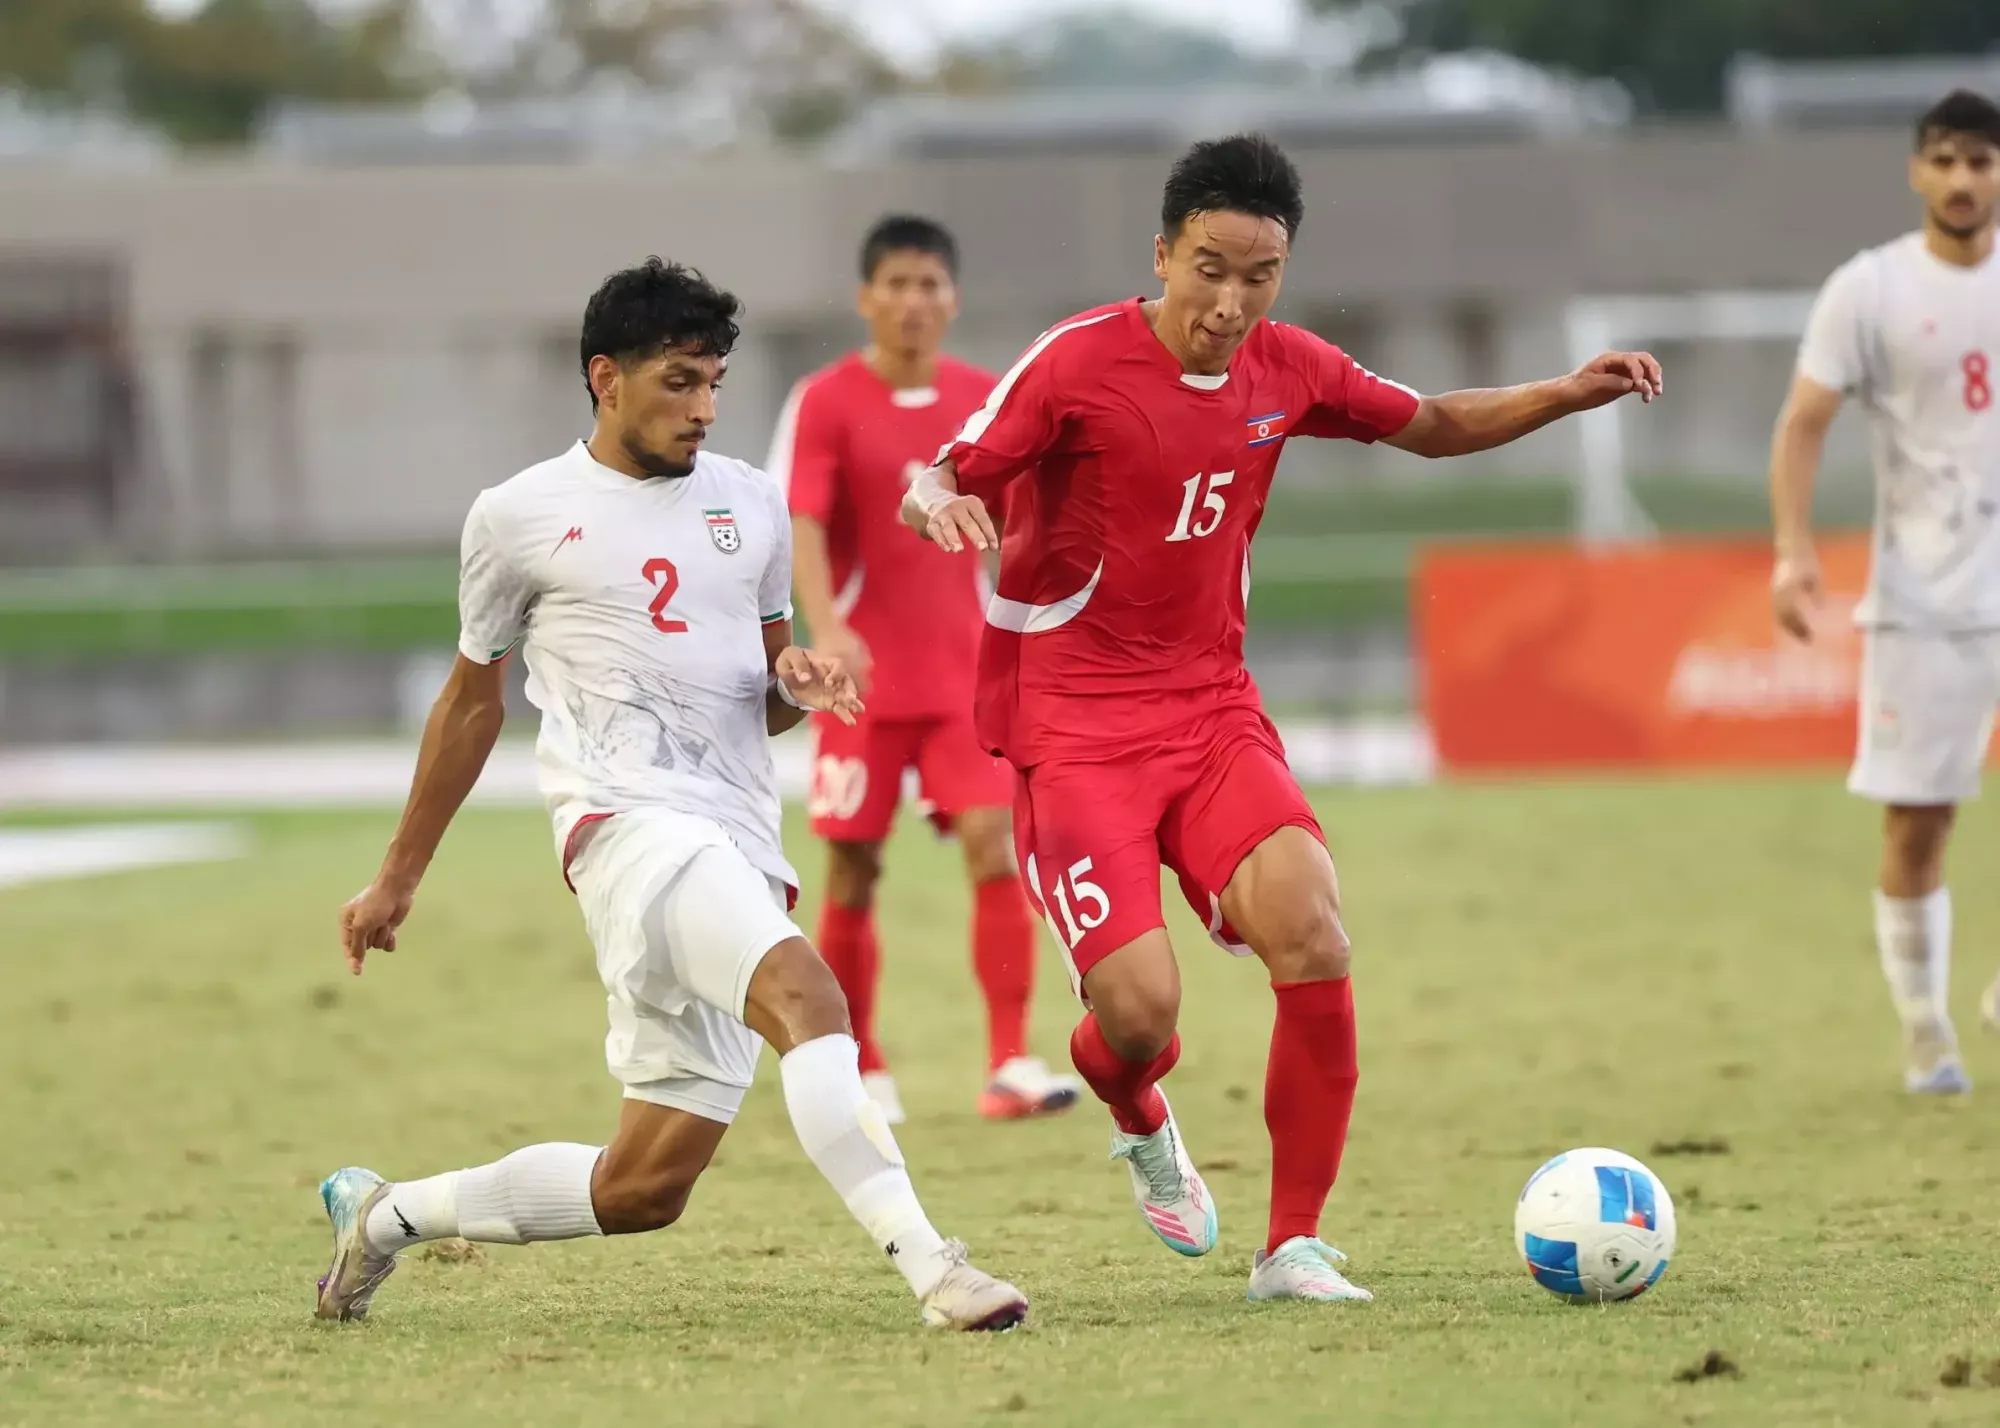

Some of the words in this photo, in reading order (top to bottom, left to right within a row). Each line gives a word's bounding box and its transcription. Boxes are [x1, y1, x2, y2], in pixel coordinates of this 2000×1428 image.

[1962, 352, 1991, 411] 8
[1165, 470, 1236, 543] 15
[642, 558, 688, 634] 2
[1052, 856, 1111, 949] 15
